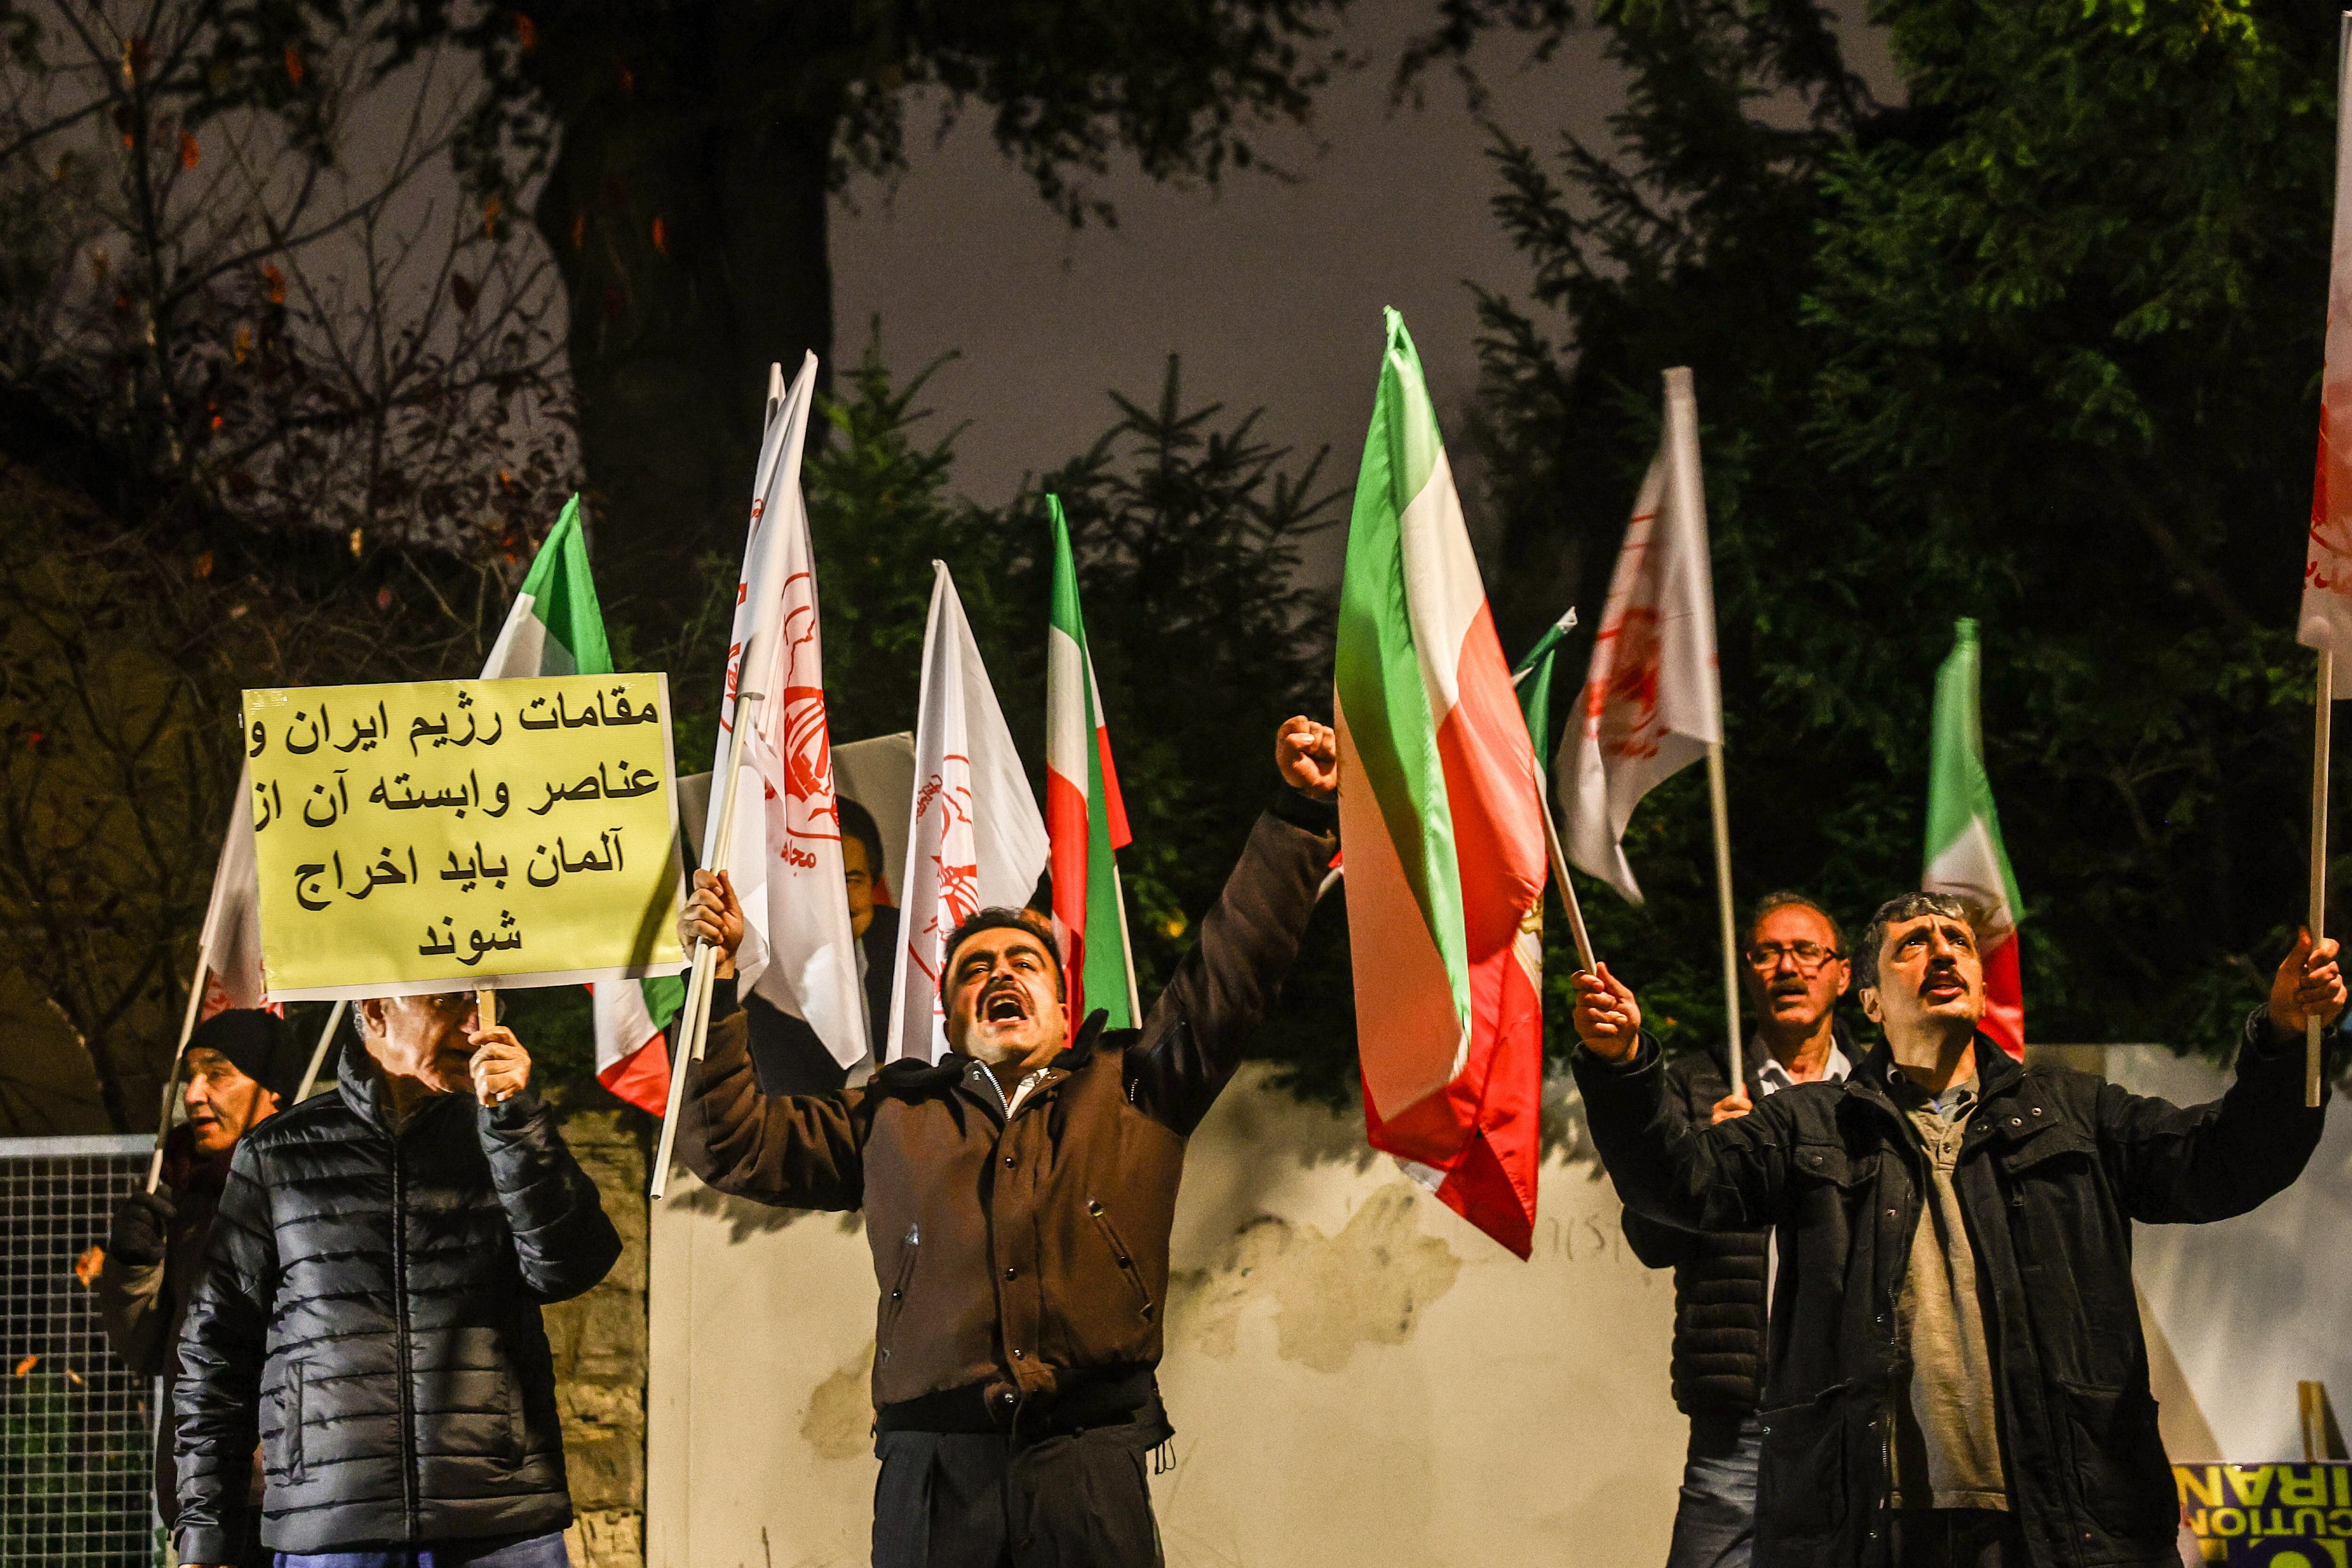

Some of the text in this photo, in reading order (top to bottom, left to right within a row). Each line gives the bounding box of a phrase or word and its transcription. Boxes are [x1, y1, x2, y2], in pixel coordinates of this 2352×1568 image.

[249, 685, 659, 758] مقامات رژیم ایران و
[254, 760, 660, 832] عناصر وابسته آن از
[294, 827, 623, 911] آلمان باید اخراج
[418, 909, 523, 966] شوند
[2172, 1465, 2351, 1506] IRAN
